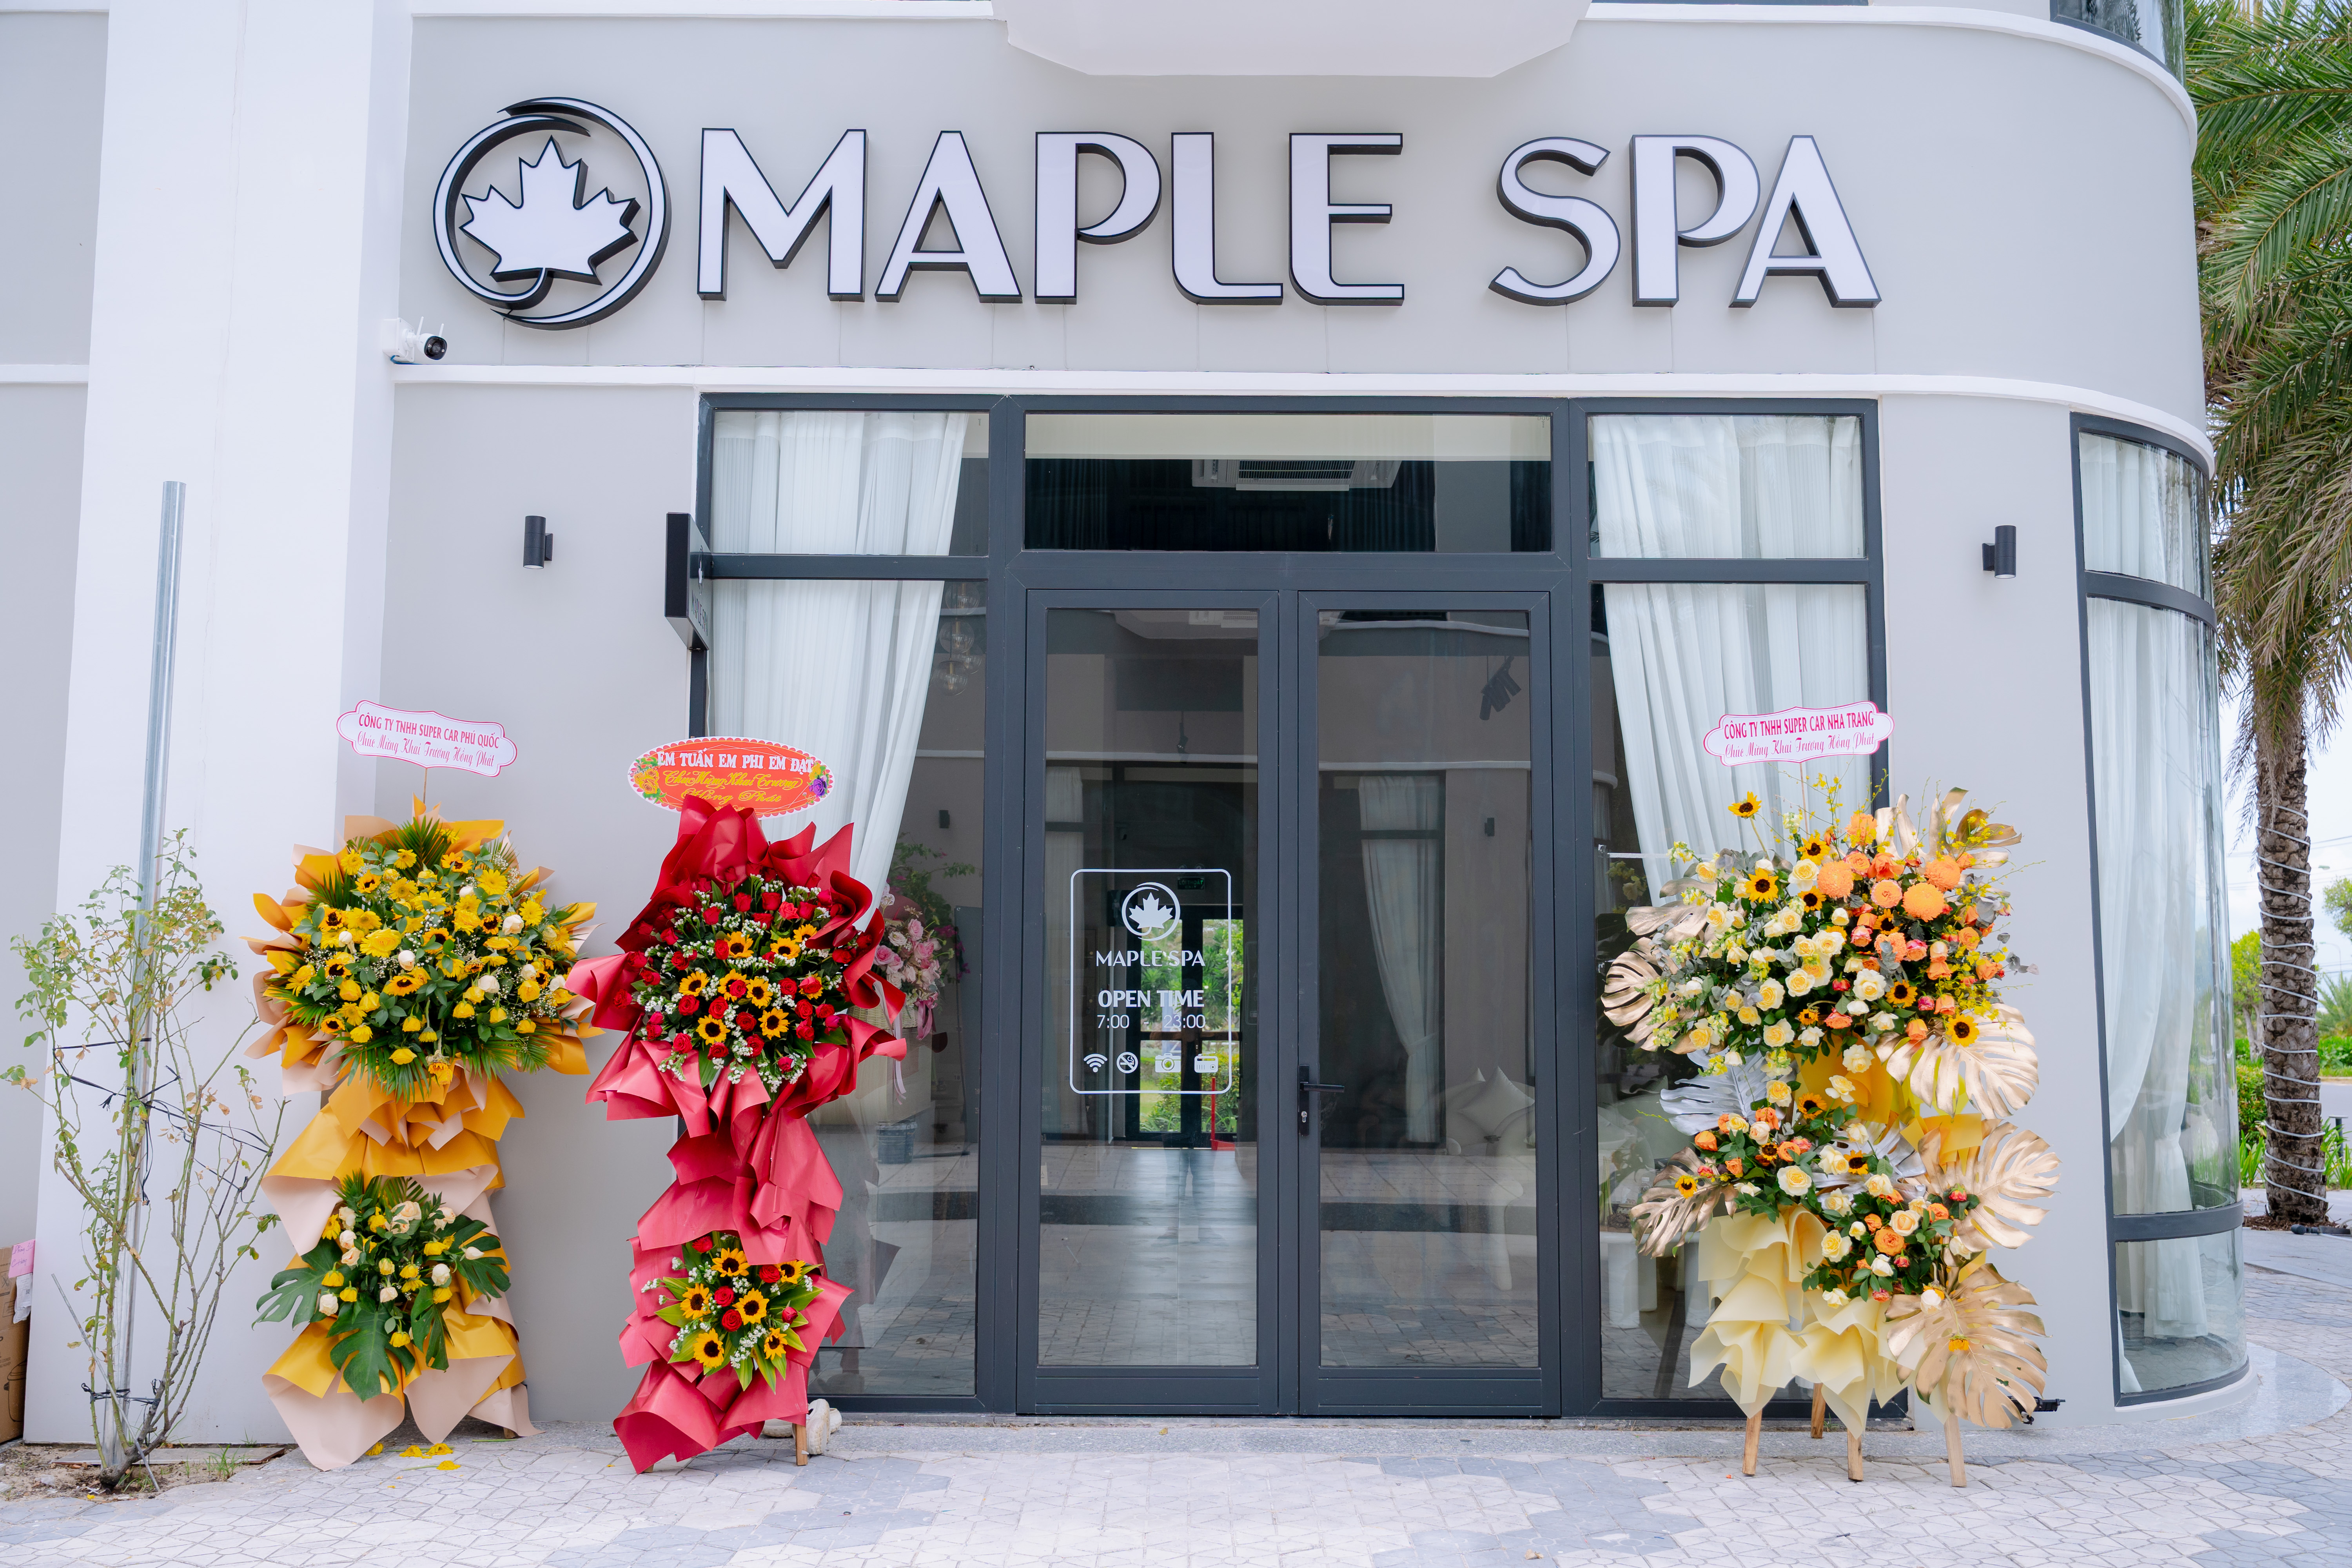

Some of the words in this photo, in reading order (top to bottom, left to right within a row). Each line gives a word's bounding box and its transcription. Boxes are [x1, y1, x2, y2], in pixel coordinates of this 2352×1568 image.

[697, 128, 1405, 306] MAPLE
[1488, 134, 1882, 308] SPA
[691, 590, 702, 626] MAPLE
[359, 713, 382, 729] CÔNG
[385, 719, 394, 731] TY
[396, 720, 417, 735] TNHH
[419, 724, 441, 739] SUPER
[444, 728, 459, 742] CAR
[460, 730, 475, 744] PHÚ
[477, 732, 500, 749] QUỐC
[1724, 720, 1747, 739] CÔNG
[1749, 721, 1759, 737] TY
[1760, 720, 1782, 736] TNHH
[1784, 717, 1808, 733] SUPER
[1809, 716, 1826, 731] CAR
[1827, 714, 1845, 730] NHA
[1847, 710, 1874, 728] TRANG
[357, 731, 375, 748] Chúc
[377, 735, 399, 755] Mừng
[401, 738, 421, 755] Khai
[423, 742, 450, 762] Trương
[452, 746, 473, 768] Hồng
[475, 750, 495, 768] Phát
[1725, 743, 1744, 759] Chúc
[1746, 741, 1768, 758] Mừng
[1771, 739, 1792, 754] Khai
[1794, 737, 1824, 753] Trương
[1827, 734, 1850, 750] Hồng
[1852, 732, 1875, 750] Phát
[657, 751, 675, 766] EM
[680, 747, 713, 768] TUẤN
[719, 754, 736, 768] EM
[742, 755, 763, 769] PHI
[769, 756, 786, 770] EM
[790, 757, 813, 775] ĐẠT
[663, 770, 695, 786] Chúc
[690, 771, 728, 789] Mừng
[726, 772, 755, 786] Khai
[754, 774, 803, 790] Trương
[738, 789, 781, 802] Phát
[1096, 950, 1162, 967] MAPLE
[1169, 950, 1205, 967] SPA
[1098, 990, 1150, 1007] OPEN
[1156, 990, 1204, 1007] TIME
[1097, 1014, 1129, 1029] 7:00
[1163, 1014, 1205, 1029] 23:00
